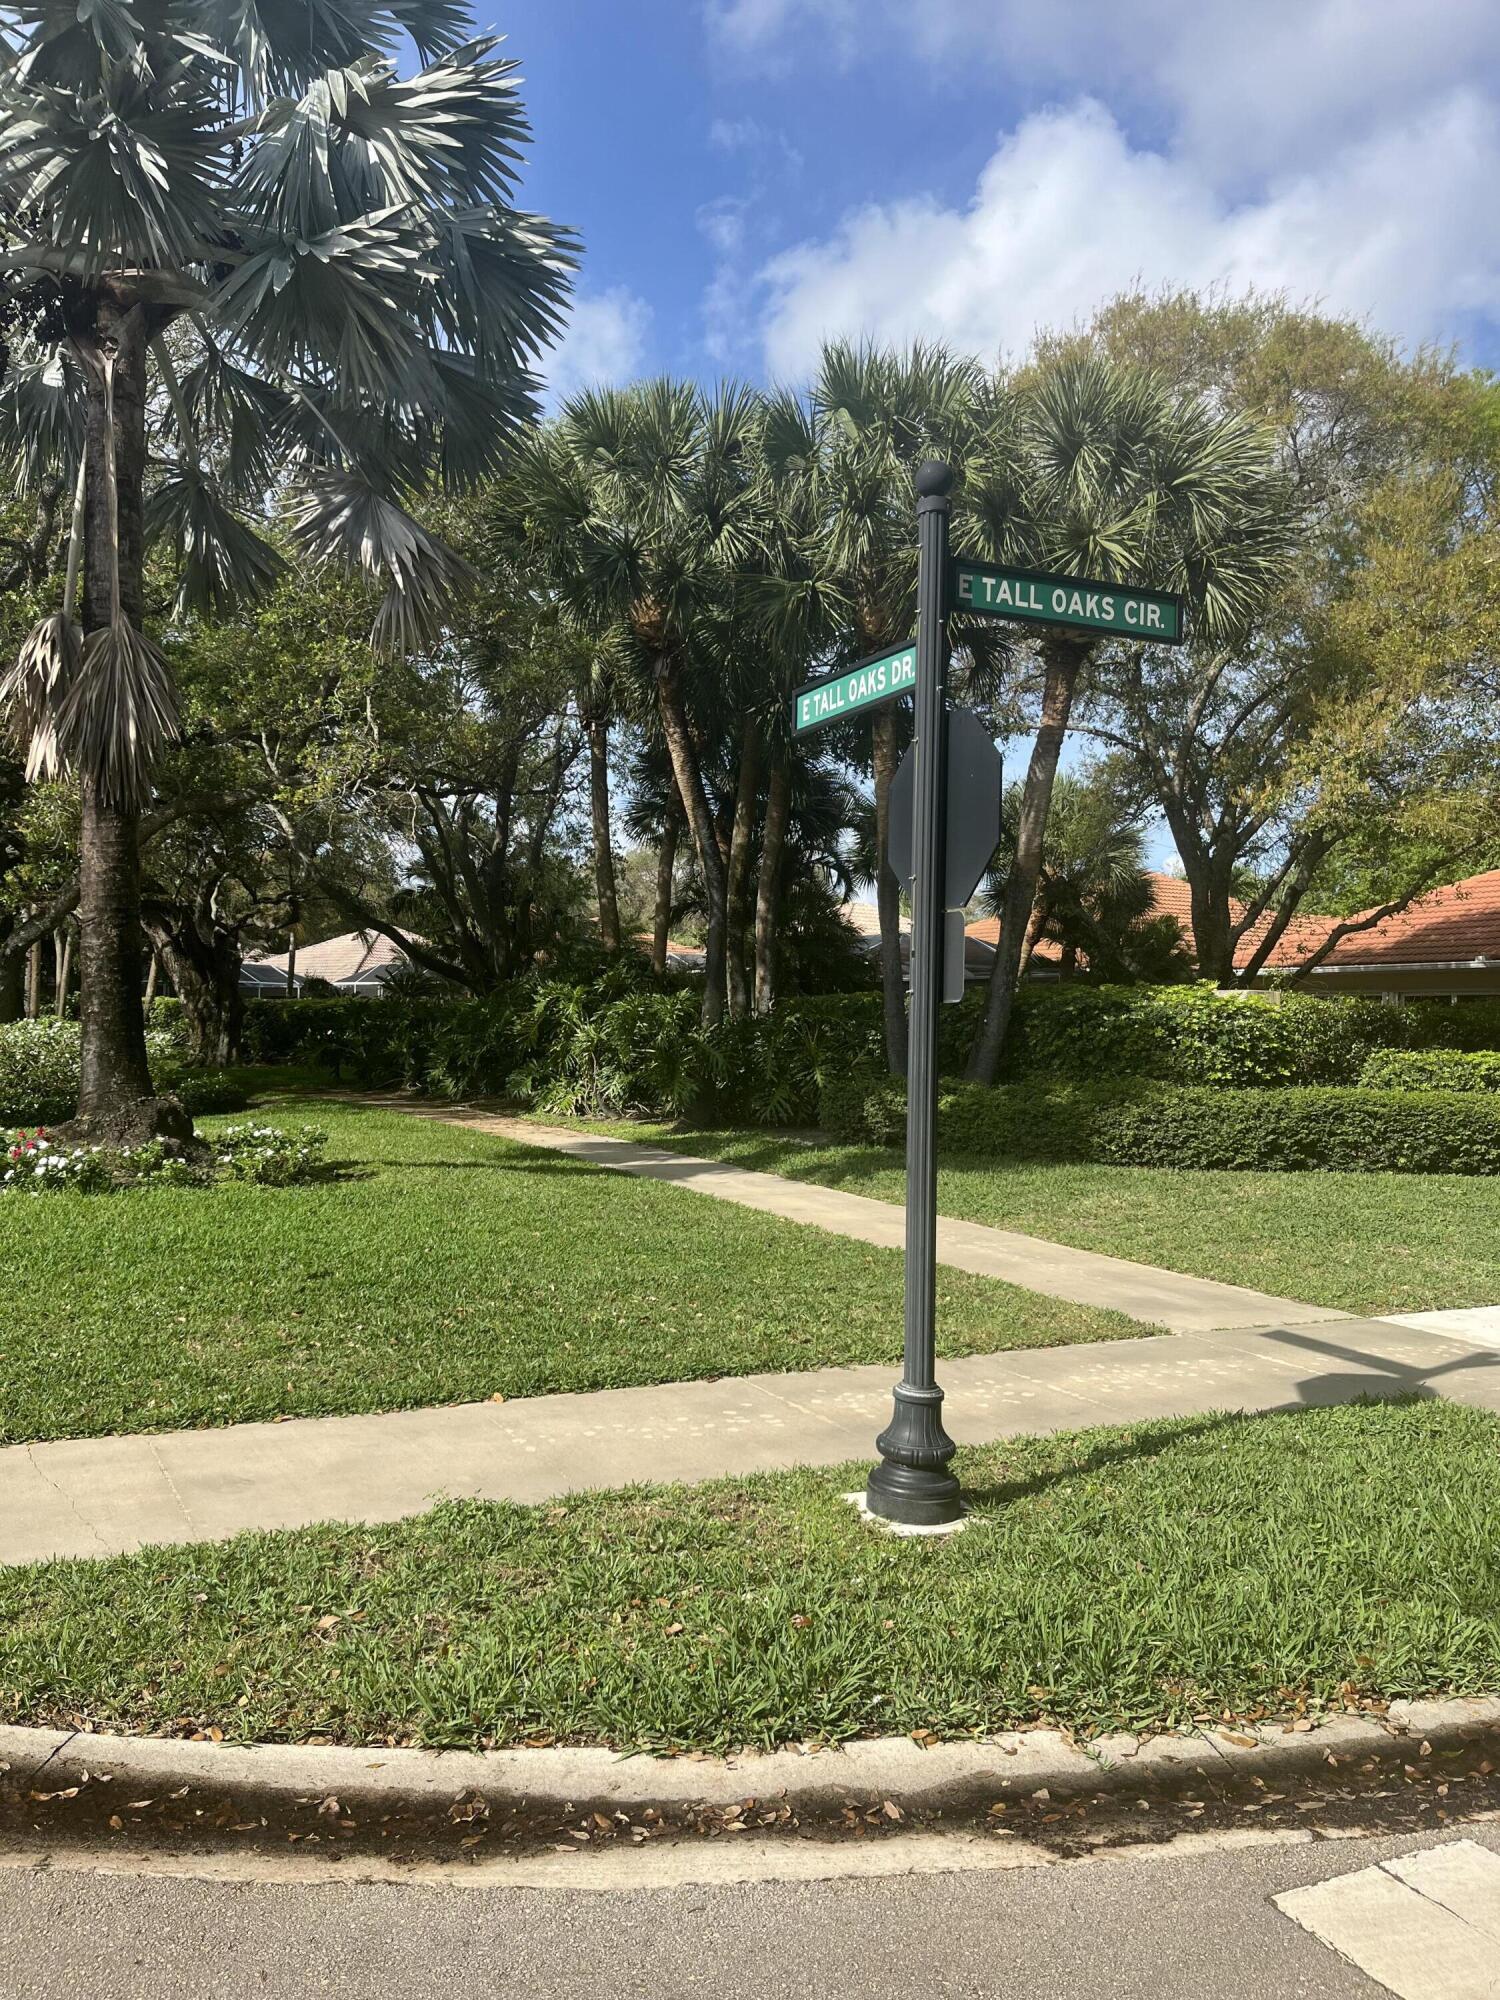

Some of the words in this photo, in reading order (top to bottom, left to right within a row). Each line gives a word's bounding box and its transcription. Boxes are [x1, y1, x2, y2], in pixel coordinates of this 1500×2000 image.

[958, 573, 973, 599] E
[982, 577, 1043, 610] TALL
[1051, 589, 1115, 621] OAKS
[1124, 600, 1165, 629] CIR.
[802, 699, 810, 722] E
[814, 685, 845, 717] TALL
[848, 666, 886, 702] OAKS
[891, 655, 915, 685] DR.
